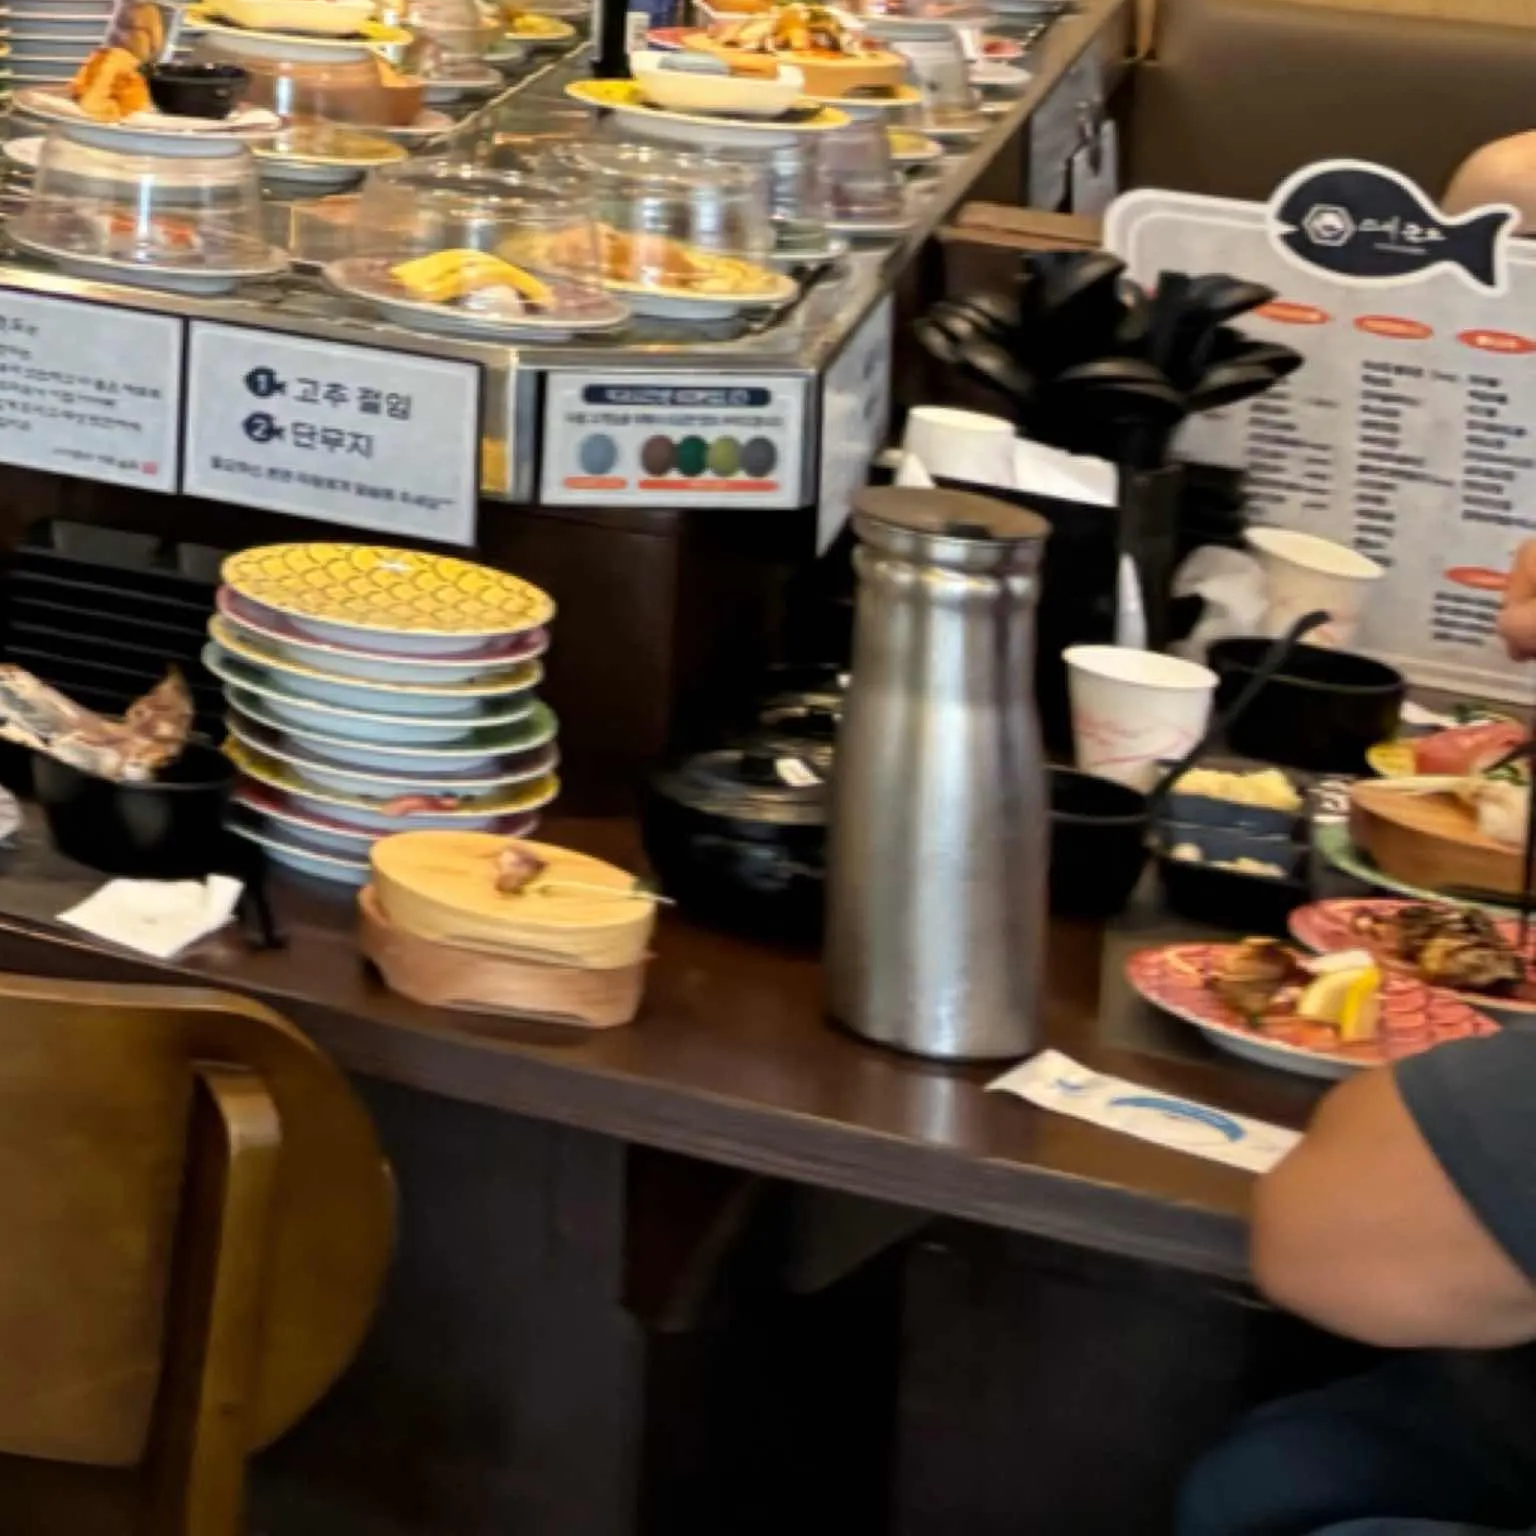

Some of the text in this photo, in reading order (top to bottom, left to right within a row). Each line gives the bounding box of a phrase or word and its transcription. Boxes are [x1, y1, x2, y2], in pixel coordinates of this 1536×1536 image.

[293, 377, 349, 408] 고추
[357, 385, 413, 421] 절임
[291, 421, 375, 460] 단무지
